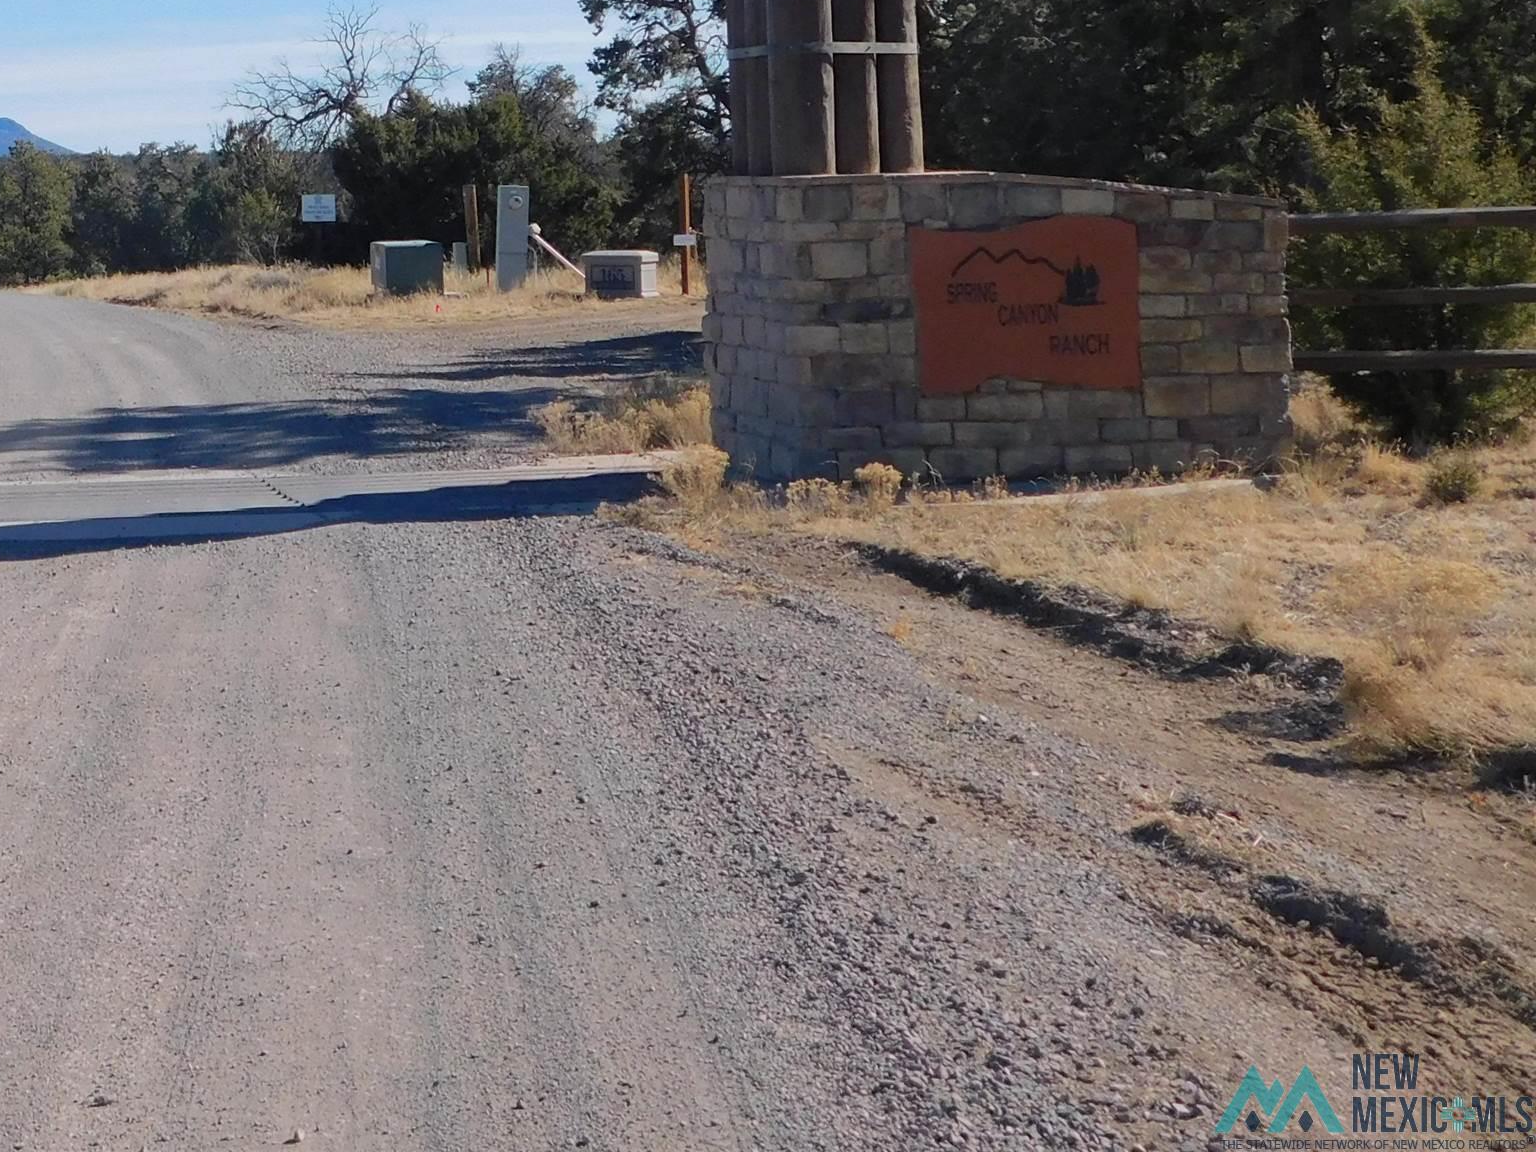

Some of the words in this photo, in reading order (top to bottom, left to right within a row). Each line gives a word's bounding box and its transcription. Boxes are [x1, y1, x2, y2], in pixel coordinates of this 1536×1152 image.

[946, 282, 998, 304] SPRING
[998, 304, 1059, 327] CANYON
[1049, 333, 1110, 356] RANCH
